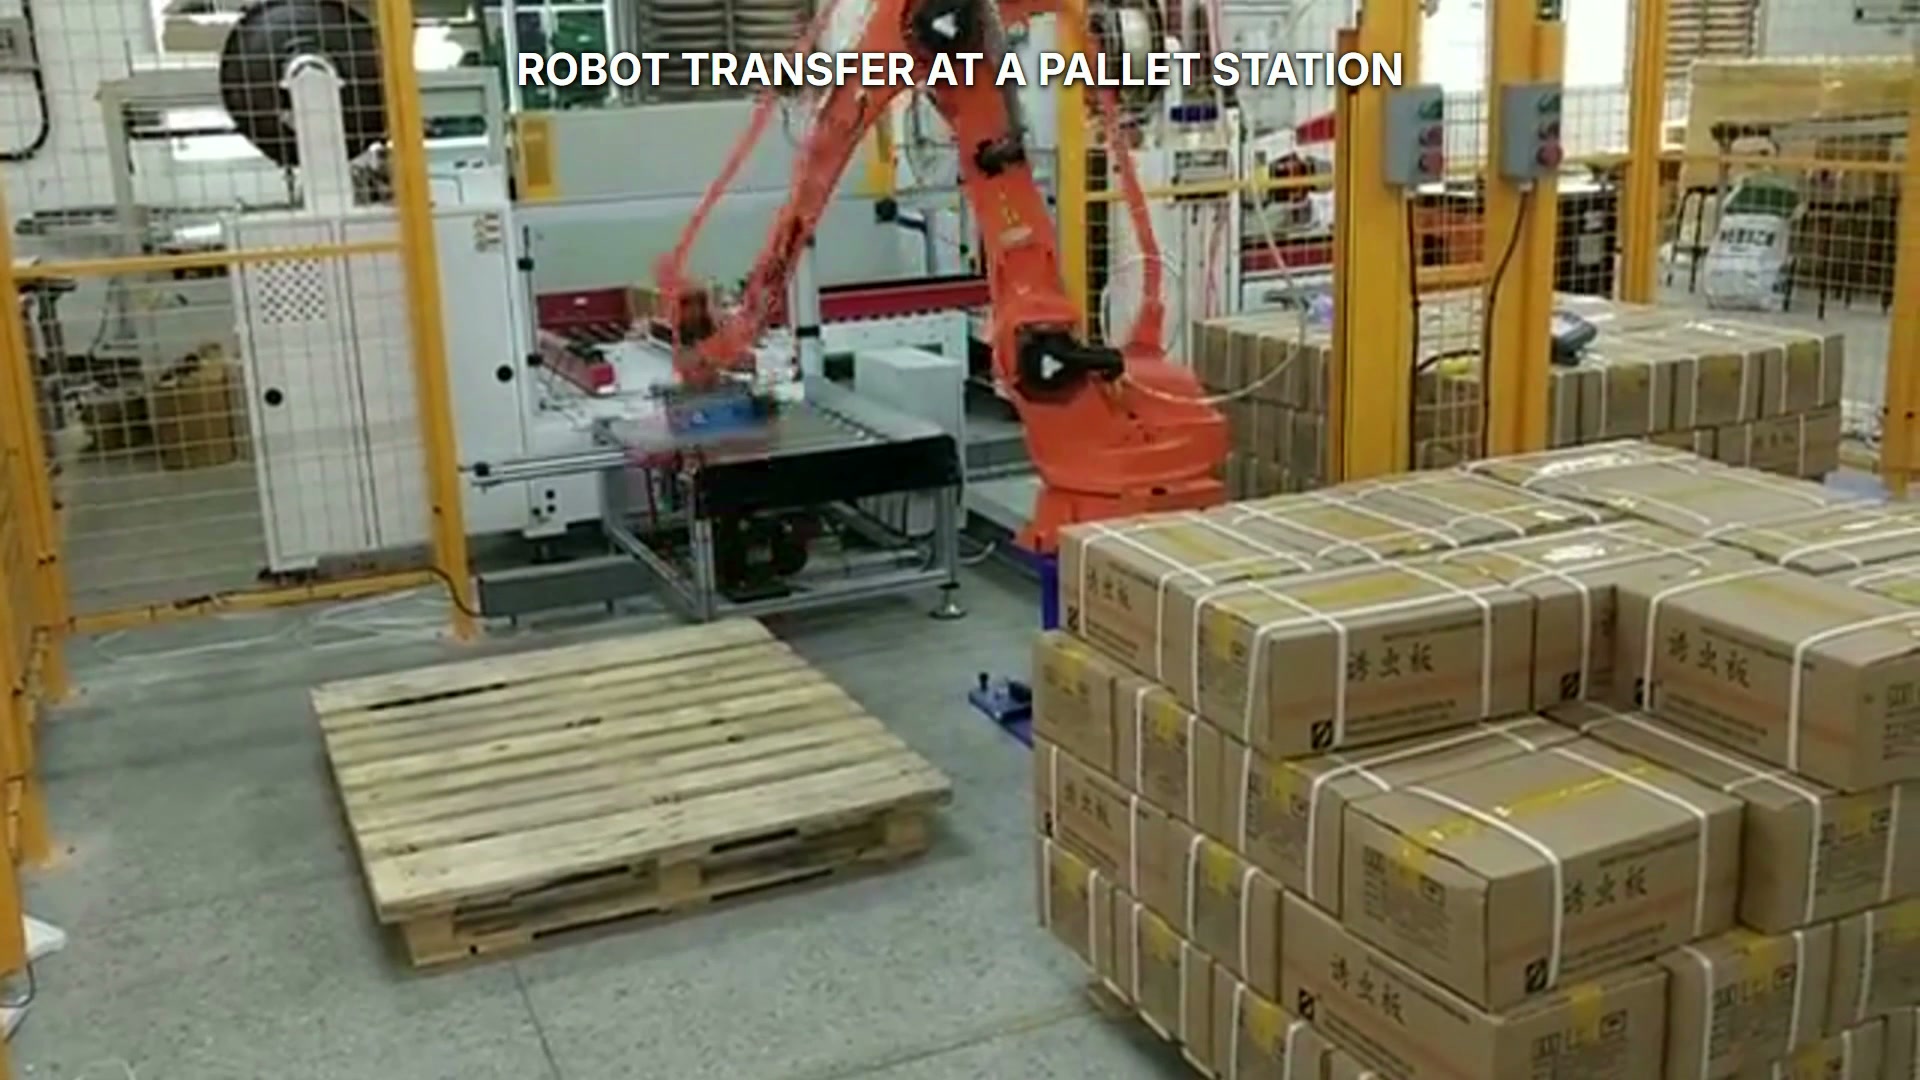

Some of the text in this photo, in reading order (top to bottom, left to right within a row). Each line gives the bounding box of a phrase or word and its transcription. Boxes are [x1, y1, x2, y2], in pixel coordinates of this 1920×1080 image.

[1347, 642, 1435, 681] 诱虫板
[1668, 628, 1750, 689] 诱虫板
[1563, 865, 1648, 916] 诱虫板
[1330, 952, 1405, 1026] 诱虫板
